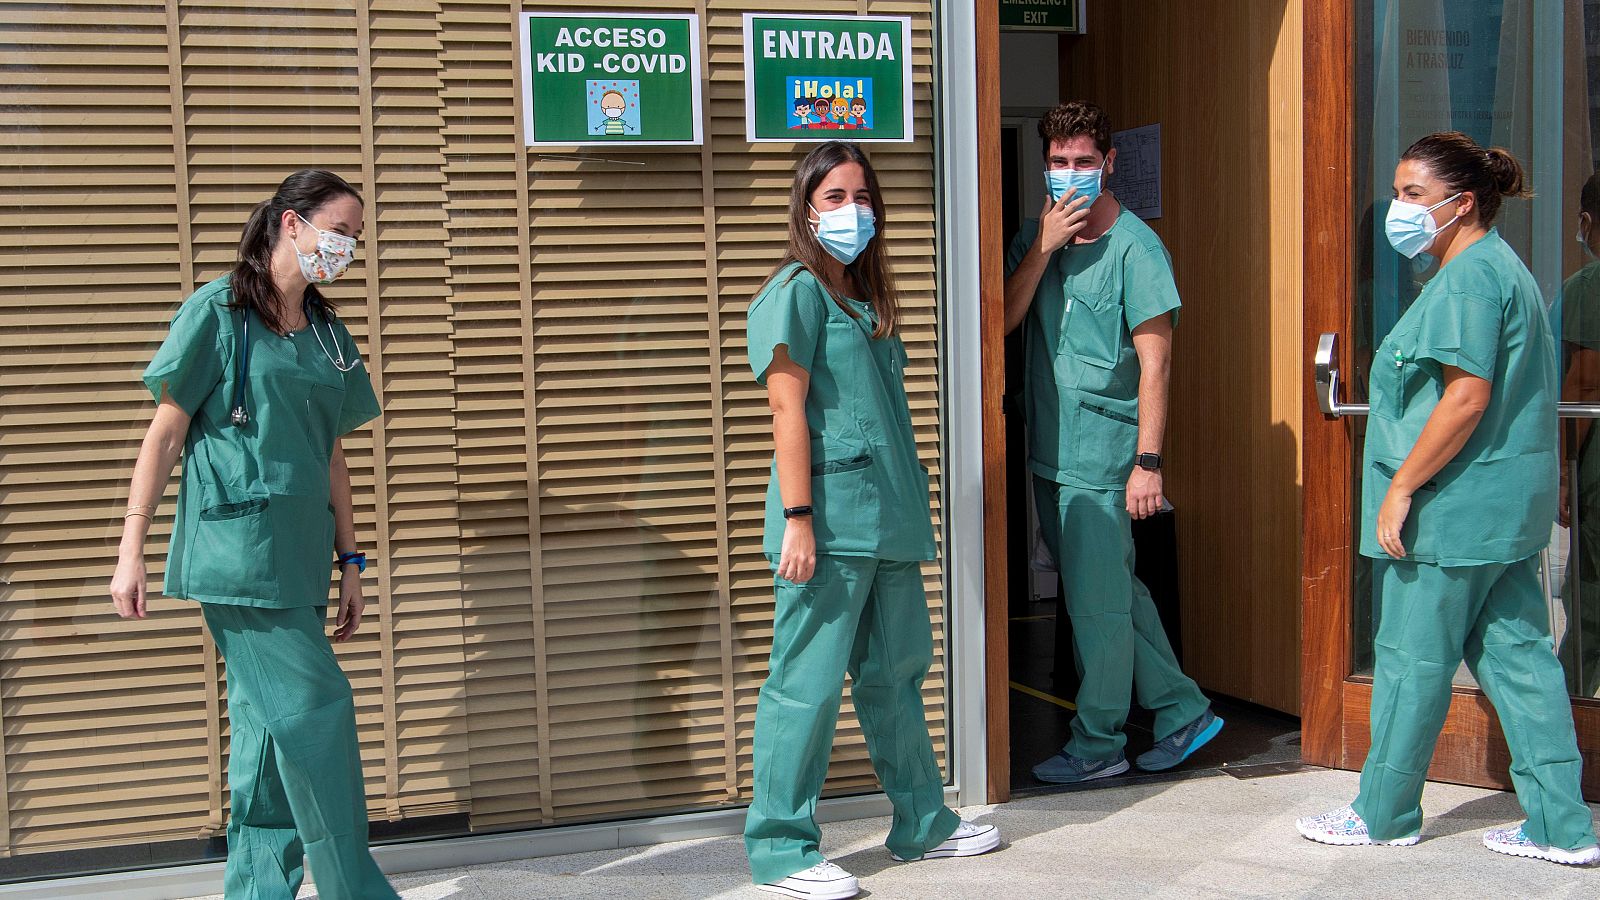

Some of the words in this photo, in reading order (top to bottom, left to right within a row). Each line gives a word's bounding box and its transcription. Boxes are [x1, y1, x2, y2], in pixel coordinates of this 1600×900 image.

[1023, 11, 1049, 24] EXIT
[554, 27, 667, 48] ACCESO
[763, 30, 896, 61] ENTRADA
[1407, 30, 1470, 47] BIENVENIDO
[537, 52, 586, 73] KID
[593, 53, 687, 74] -COVID
[1407, 53, 1414, 69] A
[794, 79, 863, 99] ¡Hola!
